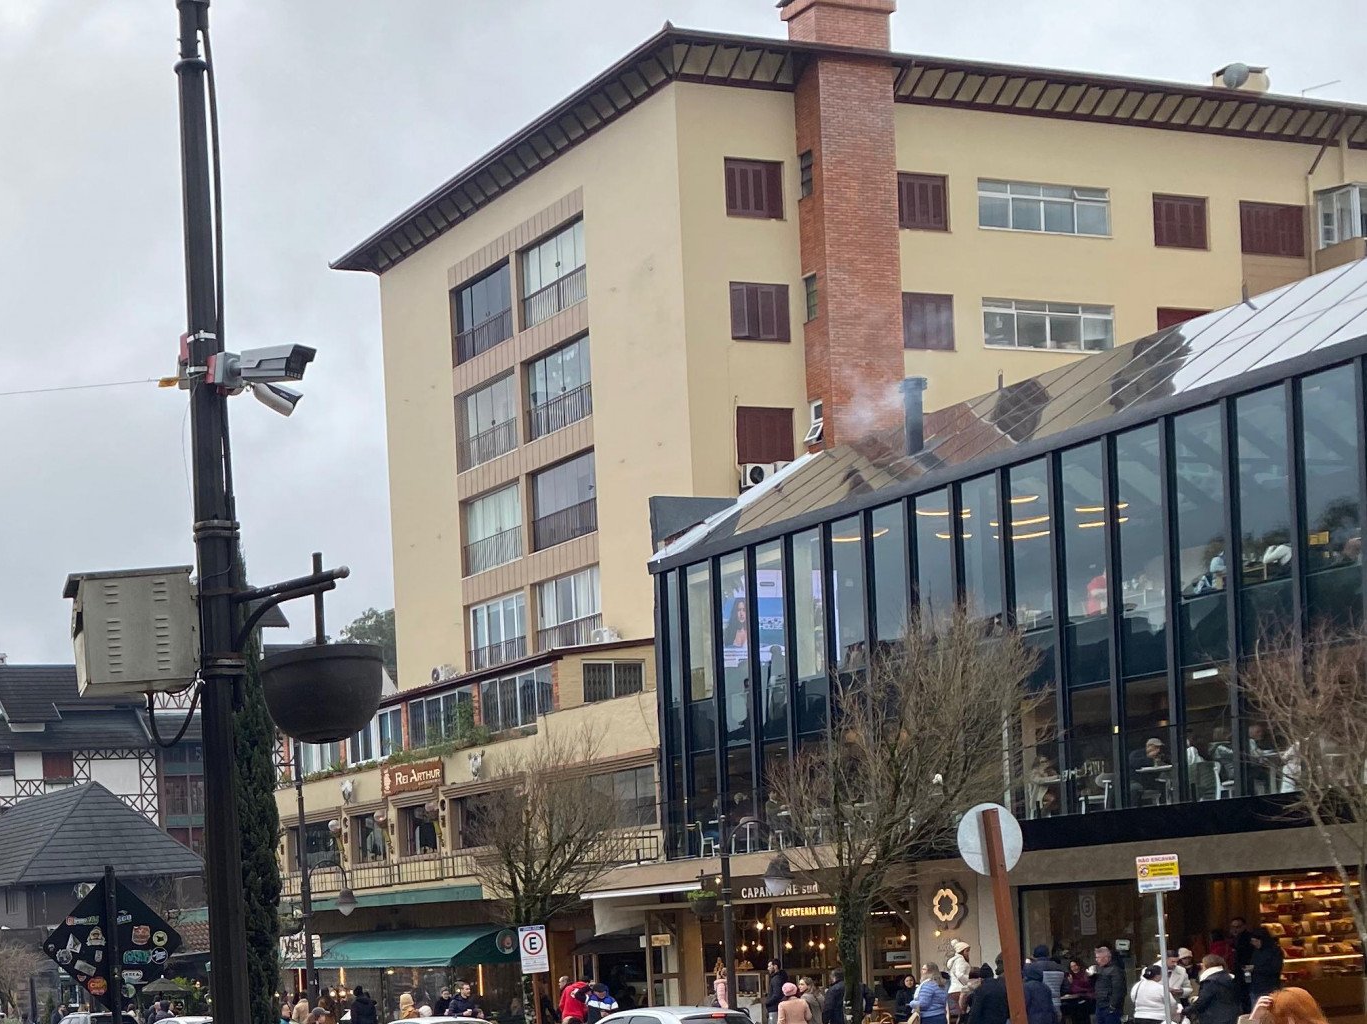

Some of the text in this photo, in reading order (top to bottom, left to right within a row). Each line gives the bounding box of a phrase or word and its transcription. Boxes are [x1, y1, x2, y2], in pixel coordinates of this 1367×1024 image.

[410, 768, 441, 783] ARTHUR
[741, 884, 799, 899] CAPANNE
[780, 905, 837, 917] CAFETERIA ITALI
[528, 936, 538, 951] E
